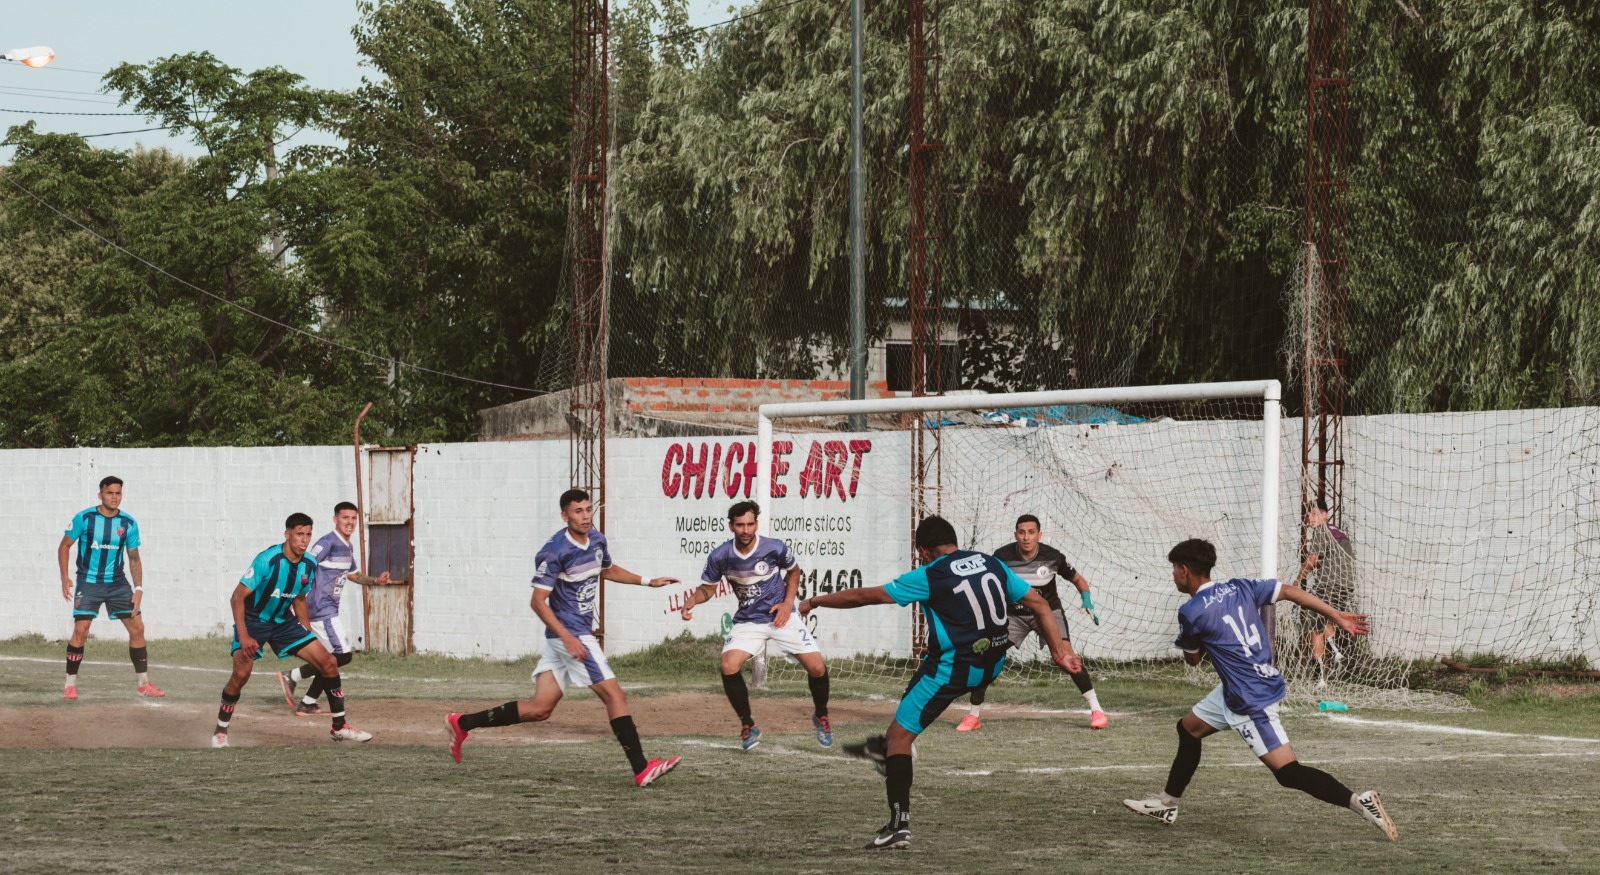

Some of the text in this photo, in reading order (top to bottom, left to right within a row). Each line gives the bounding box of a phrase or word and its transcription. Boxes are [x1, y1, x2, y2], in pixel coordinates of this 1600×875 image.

[799, 439, 872, 503] ART
[675, 514, 852, 532] Muebles rodomesticos
[680, 537, 845, 558] Ropas Bicicletas
[954, 555, 987, 573] CMP
[782, 569, 862, 601] 31460
[952, 572, 1007, 630] 10
[1222, 605, 1263, 658] 14
[1148, 808, 1177, 823] NIKE
[1359, 795, 1383, 819] NIKE
